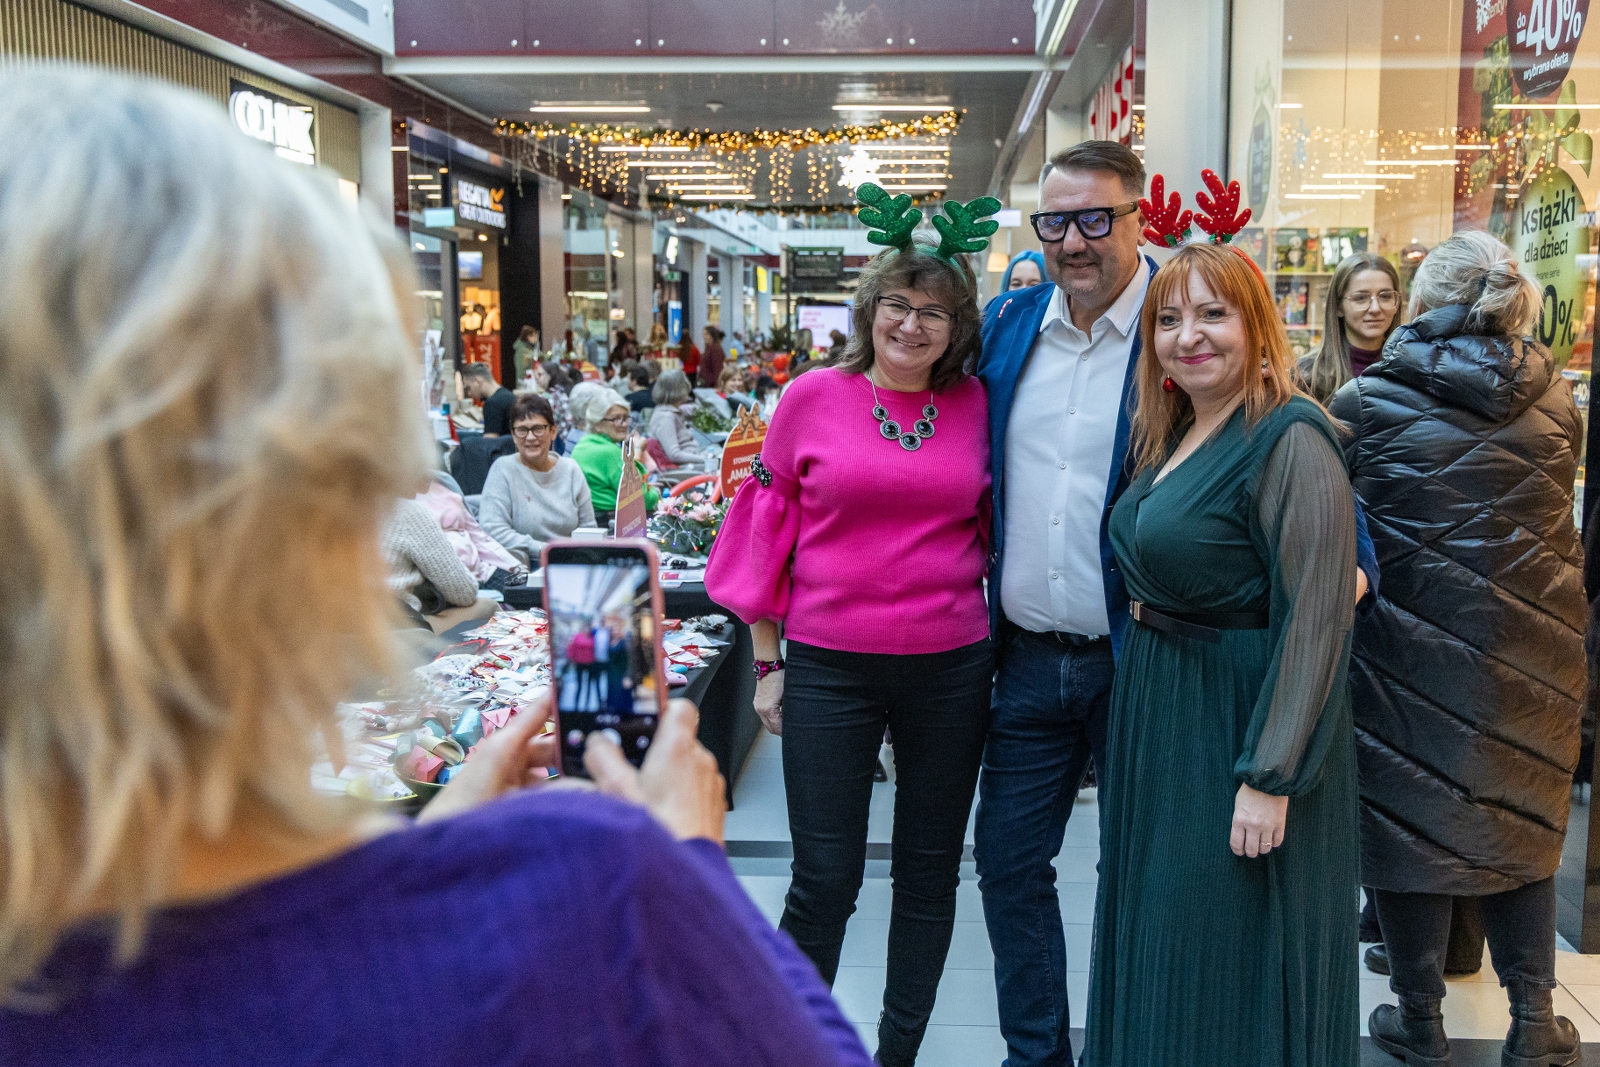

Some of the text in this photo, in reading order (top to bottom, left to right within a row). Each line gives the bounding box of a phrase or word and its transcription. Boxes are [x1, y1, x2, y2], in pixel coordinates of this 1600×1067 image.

[1516, 0, 1582, 57] -40%
[1517, 12, 1526, 29] do
[1523, 52, 1569, 82] wybrana oferta
[458, 180, 491, 209] REGATTA
[1521, 184, 1576, 236] książki
[1524, 232, 1568, 263] dla dzieci
[1532, 284, 1577, 349] 0%
